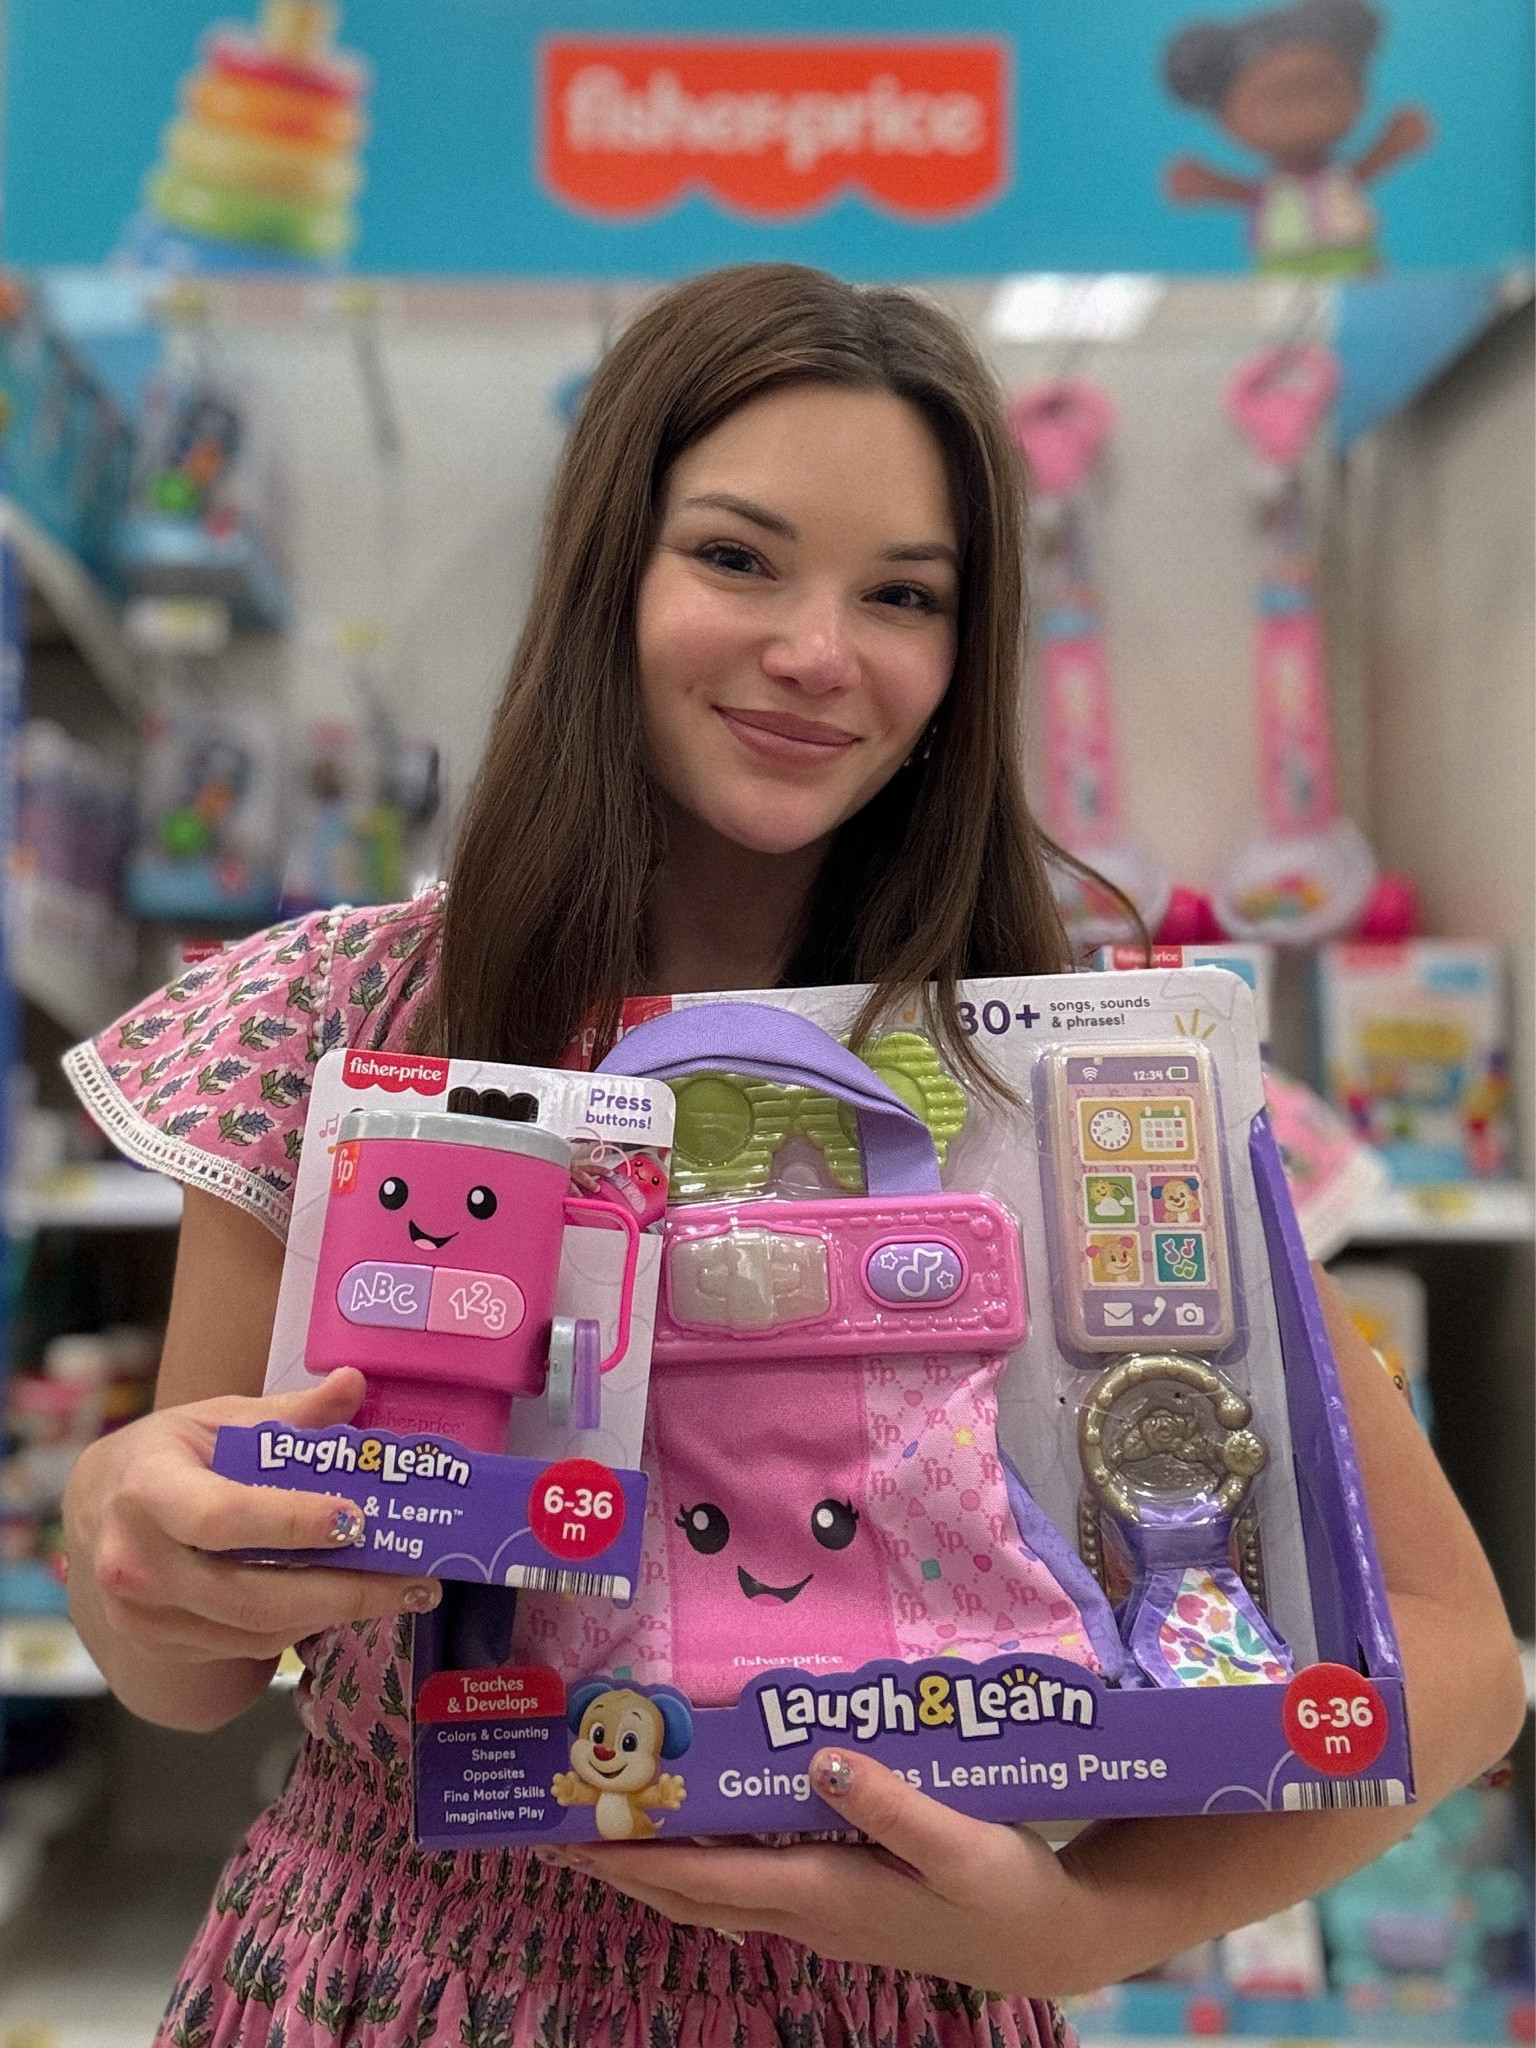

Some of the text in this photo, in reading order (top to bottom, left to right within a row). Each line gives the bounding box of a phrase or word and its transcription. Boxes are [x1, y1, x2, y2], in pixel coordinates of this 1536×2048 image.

[1050, 996, 1151, 1013] songs, sounds
[1052, 1013, 1126, 1030] & phrases!
[350, 1057, 442, 1082] fisher-price
[1134, 1070, 1163, 1081] 12:34
[590, 1088, 652, 1112] Press
[585, 1110, 652, 1129] buttons!
[337, 1147, 354, 1188] fp
[350, 1271, 418, 1315] ABC
[449, 1281, 507, 1331] 123
[260, 1431, 469, 1486] Laugh&Learn
[363, 1496, 381, 1517] &
[544, 1485, 614, 1519] 6-36
[562, 1522, 586, 1541] m
[374, 1529, 424, 1559] Mug
[733, 1653, 843, 1667] fisher-price
[461, 1675, 524, 1694] Teaches
[447, 1694, 539, 1714] & Develops
[760, 1672, 1094, 1748] Laugh&Learn
[1297, 1696, 1373, 1730] 6-36
[437, 1726, 549, 1743] Colors & Counting
[1325, 1735, 1351, 1754] m
[472, 1748, 516, 1762] Shapes
[463, 1767, 525, 1783] Opposites
[718, 1768, 811, 1801] Going
[932, 1757, 1068, 1790] Learning
[1078, 1754, 1168, 1782] Purse
[443, 1786, 545, 1803] Fine Motor Skills
[445, 1806, 545, 1825] Imaginative Play
